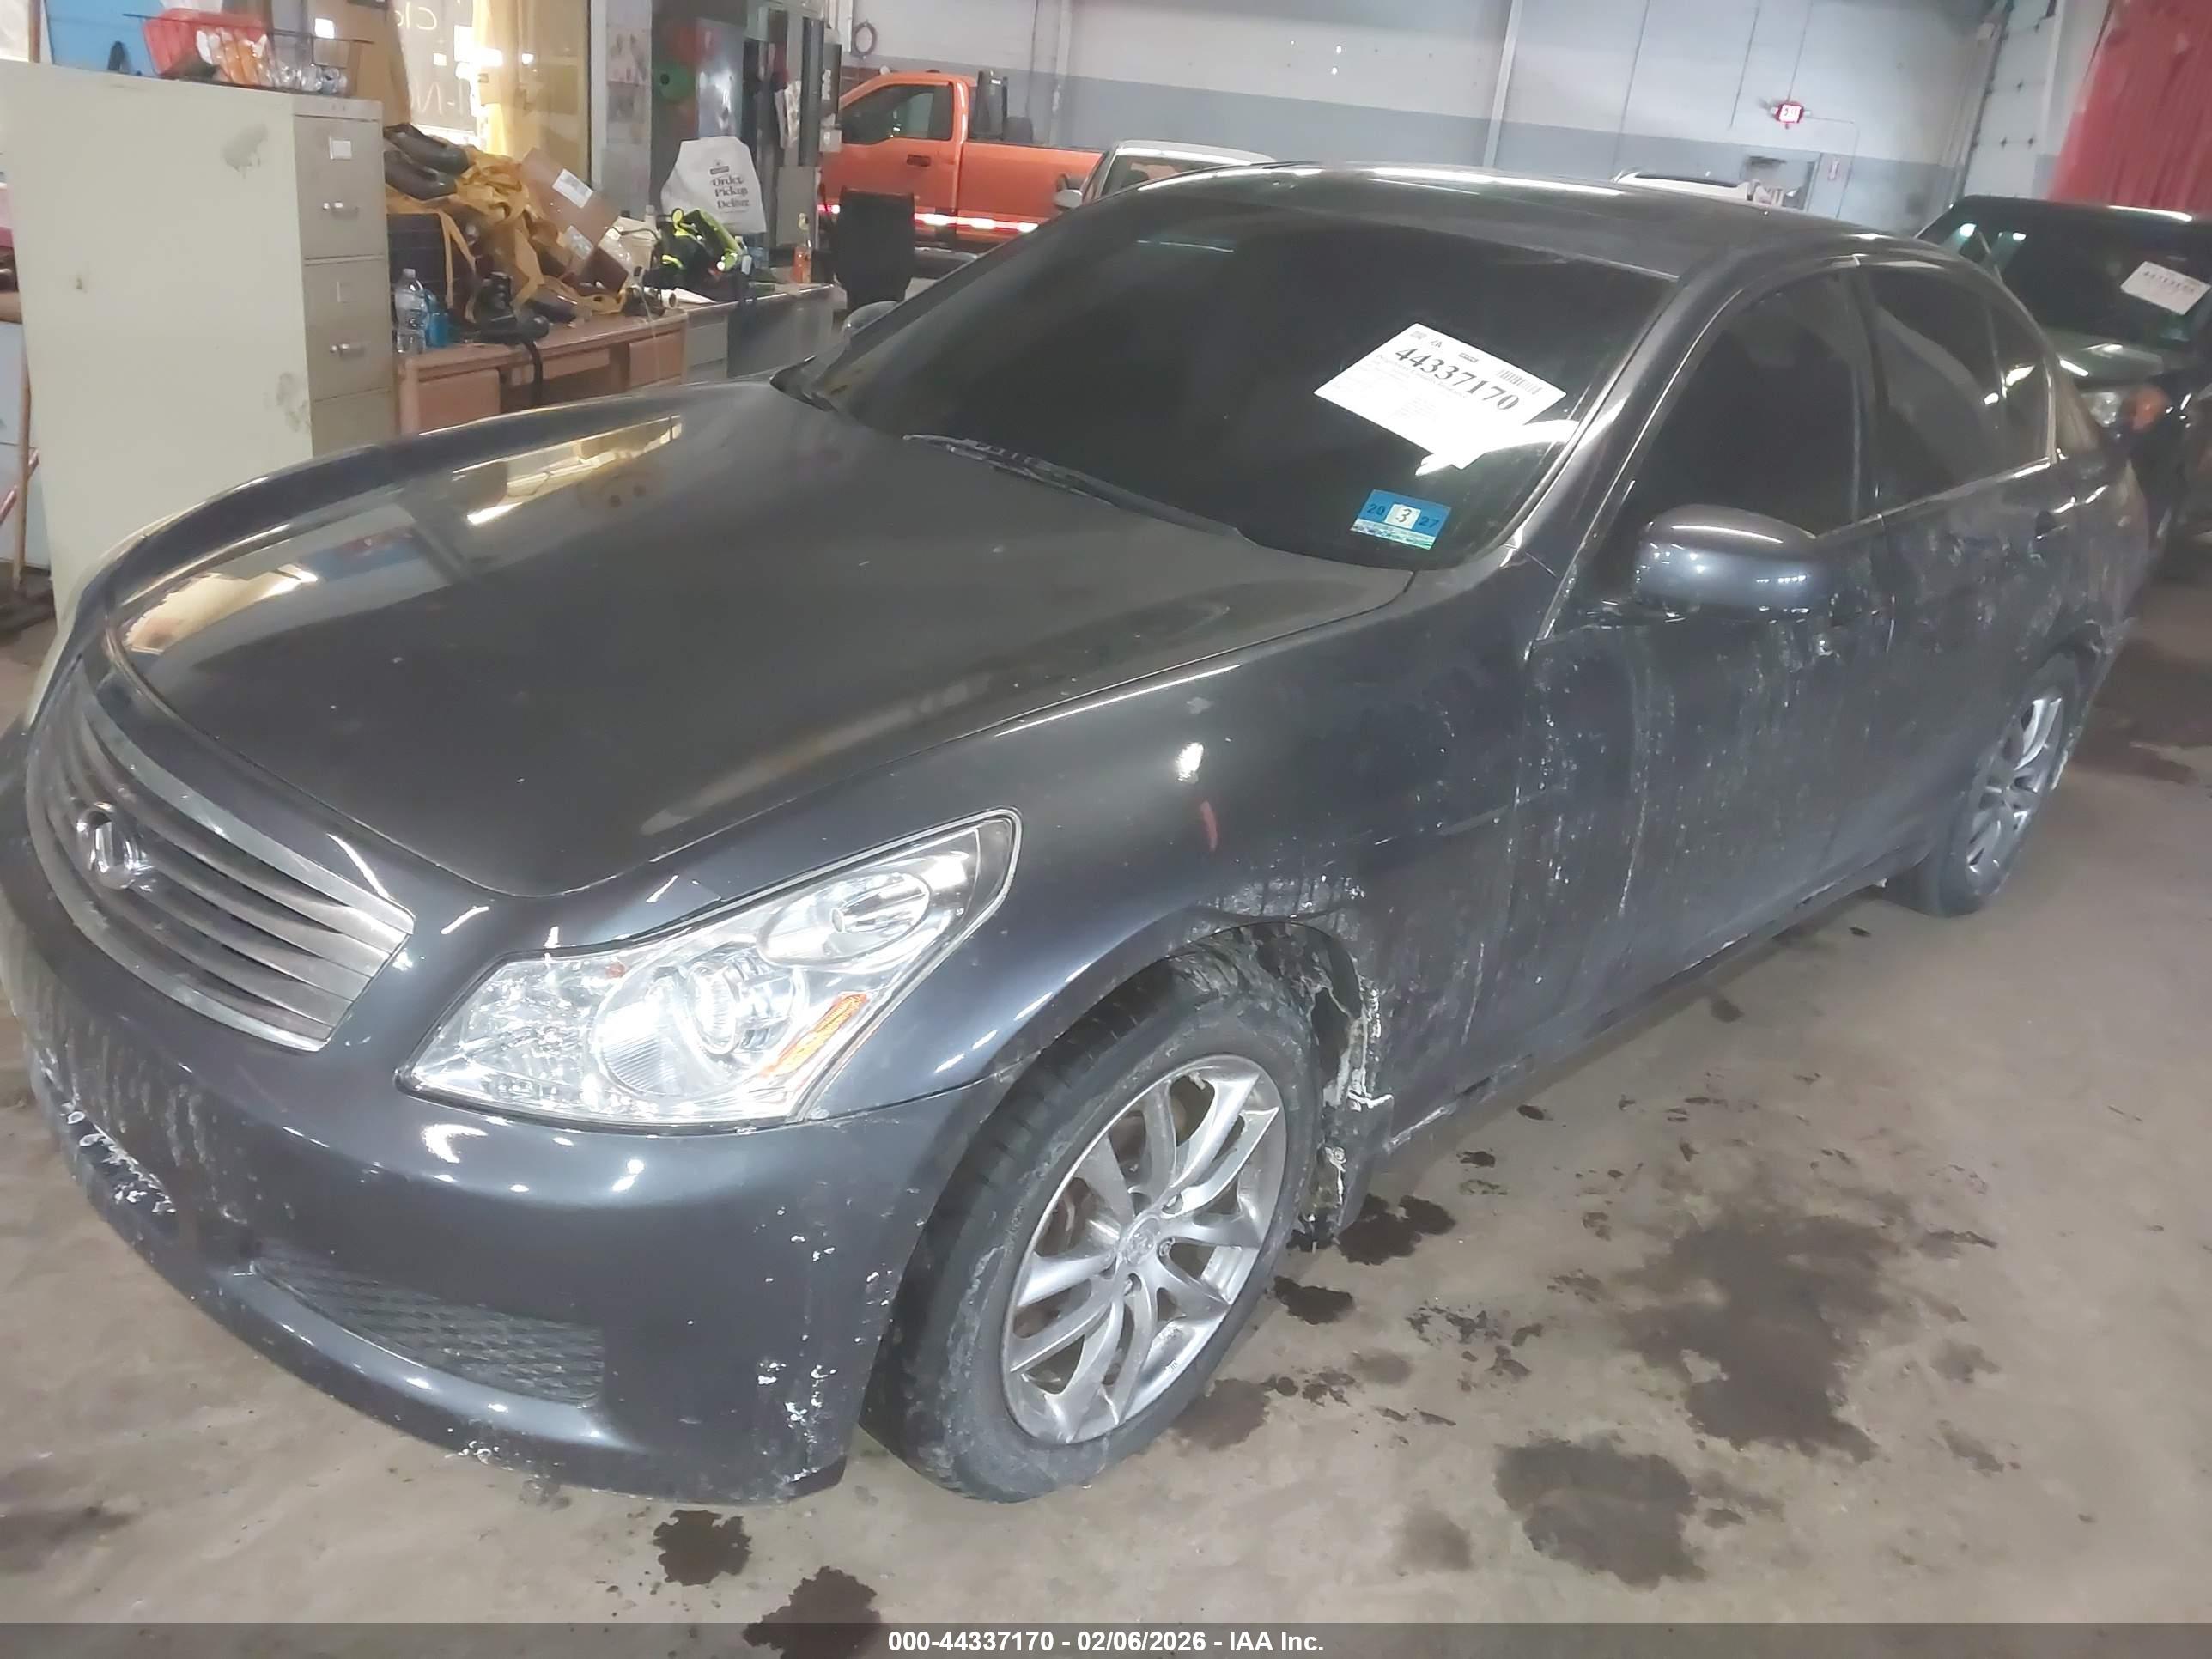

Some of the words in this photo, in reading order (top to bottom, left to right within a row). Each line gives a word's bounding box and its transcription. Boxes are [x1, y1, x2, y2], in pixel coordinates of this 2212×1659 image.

[1395, 348, 1520, 410] 44337170
[1367, 503, 1386, 516] 20
[1395, 508, 1413, 523] 3
[1419, 516, 1439, 529] 27
